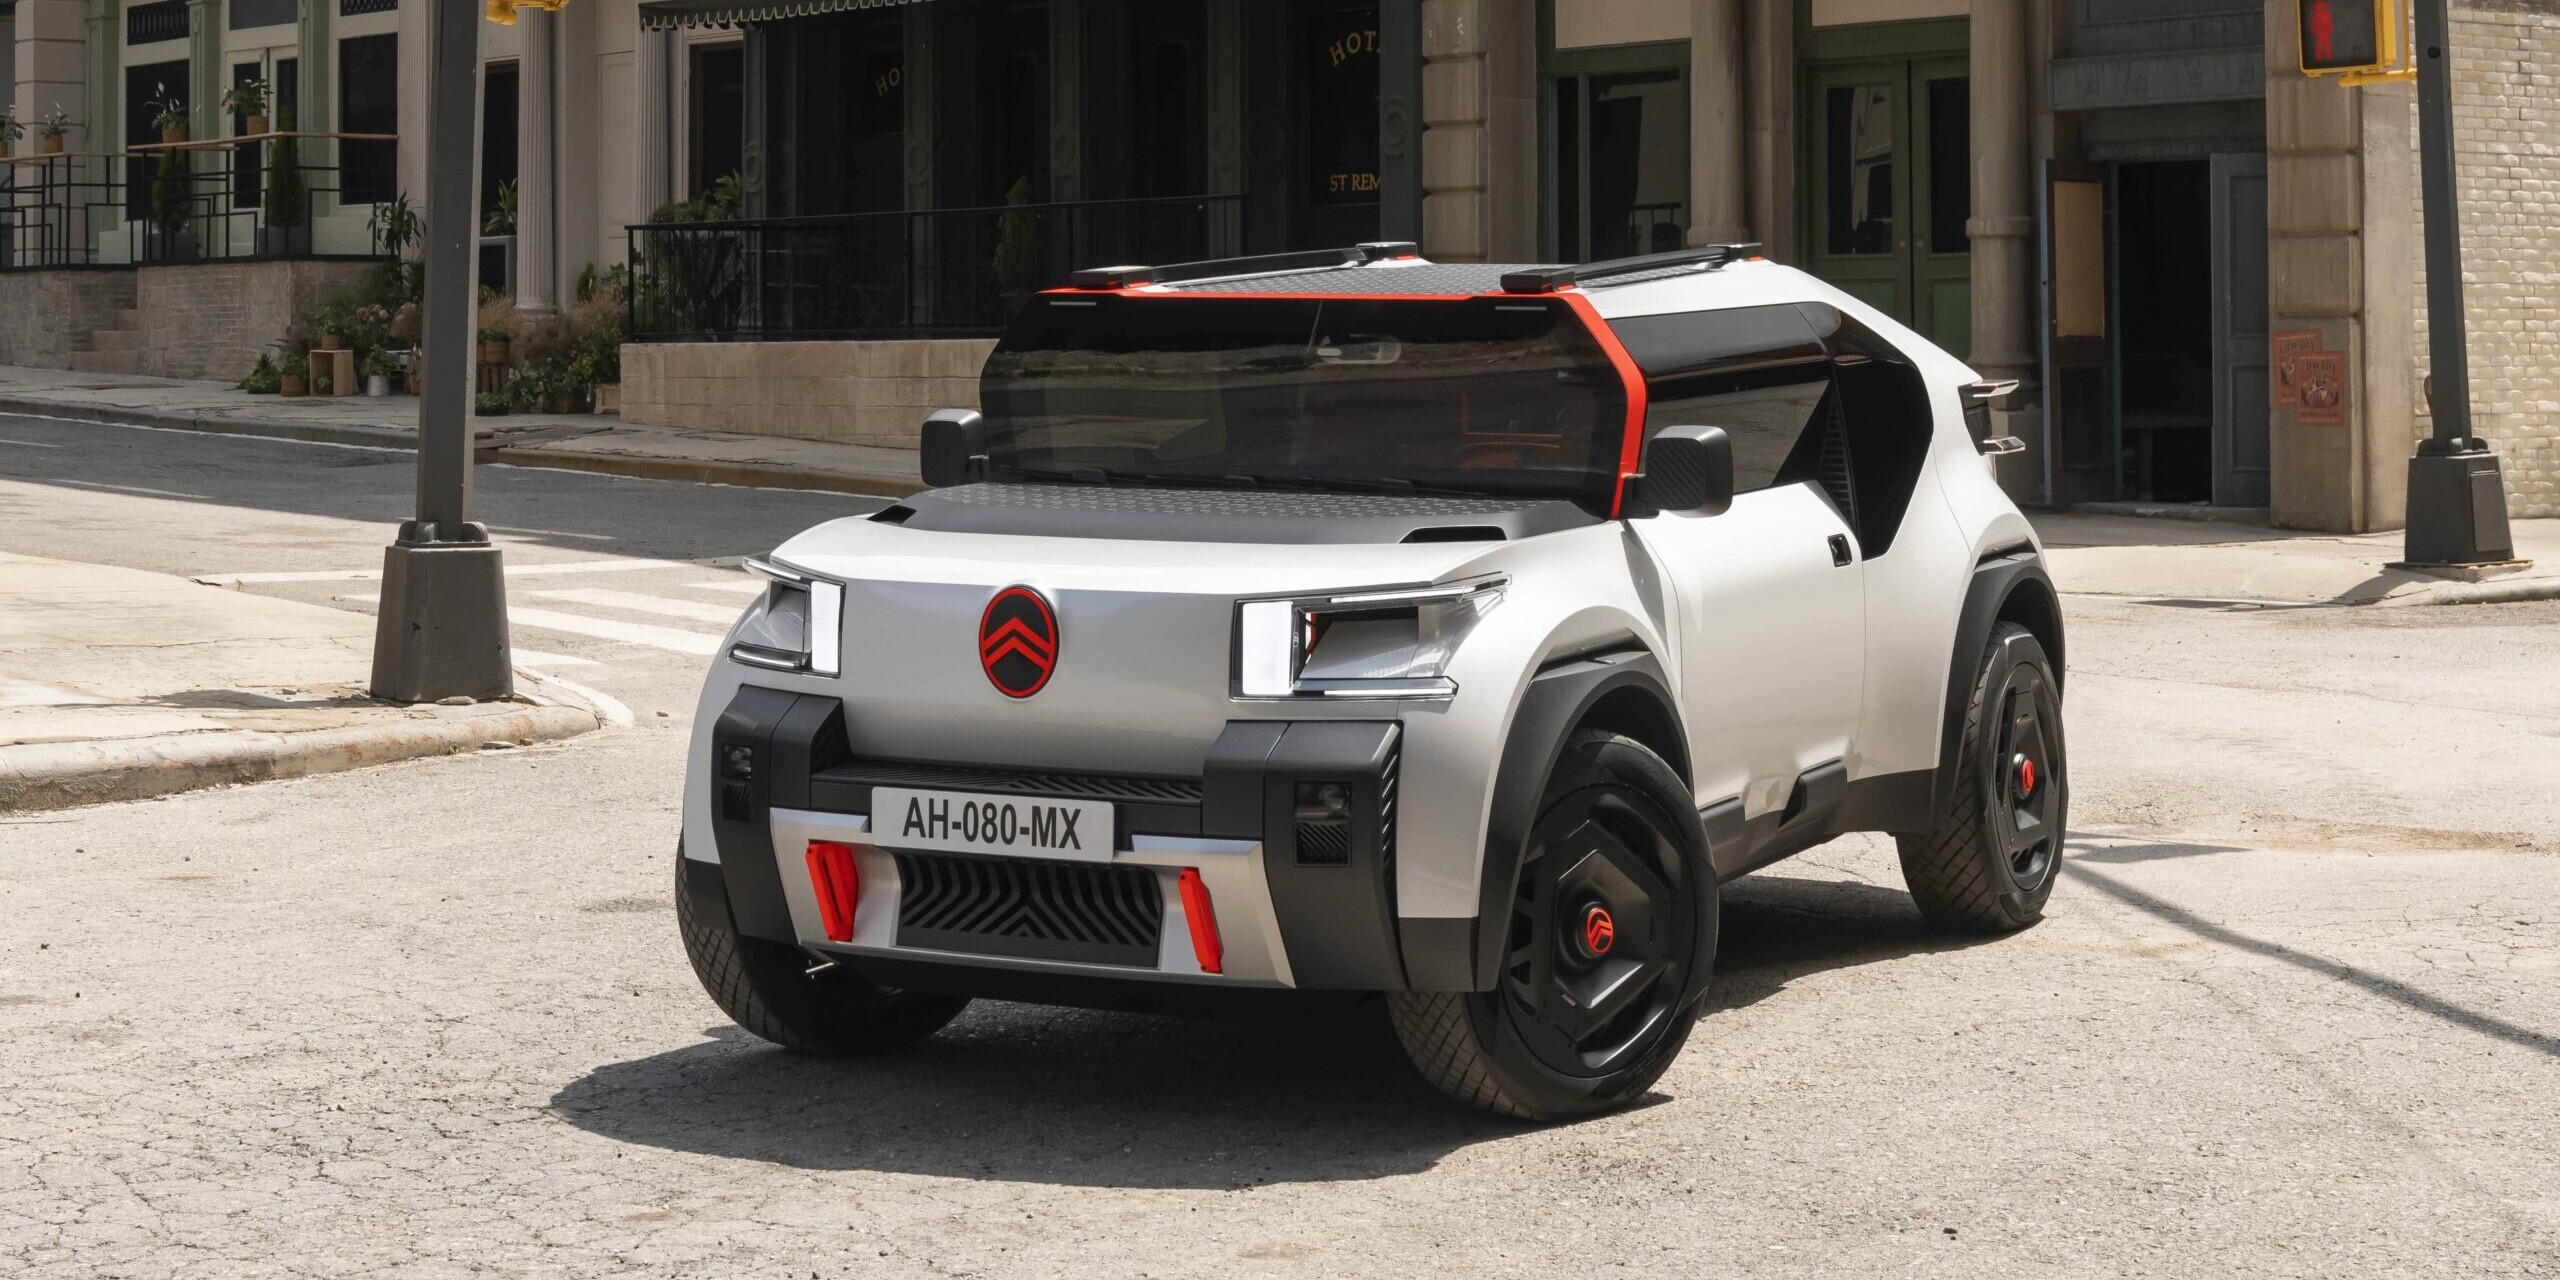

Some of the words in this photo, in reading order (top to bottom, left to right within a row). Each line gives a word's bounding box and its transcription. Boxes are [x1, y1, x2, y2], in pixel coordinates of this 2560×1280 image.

[1329, 29, 1379, 67] HOT
[876, 66, 904, 97] HO
[1330, 174, 1348, 192] ST
[902, 796, 1082, 850] AH-080-MX
